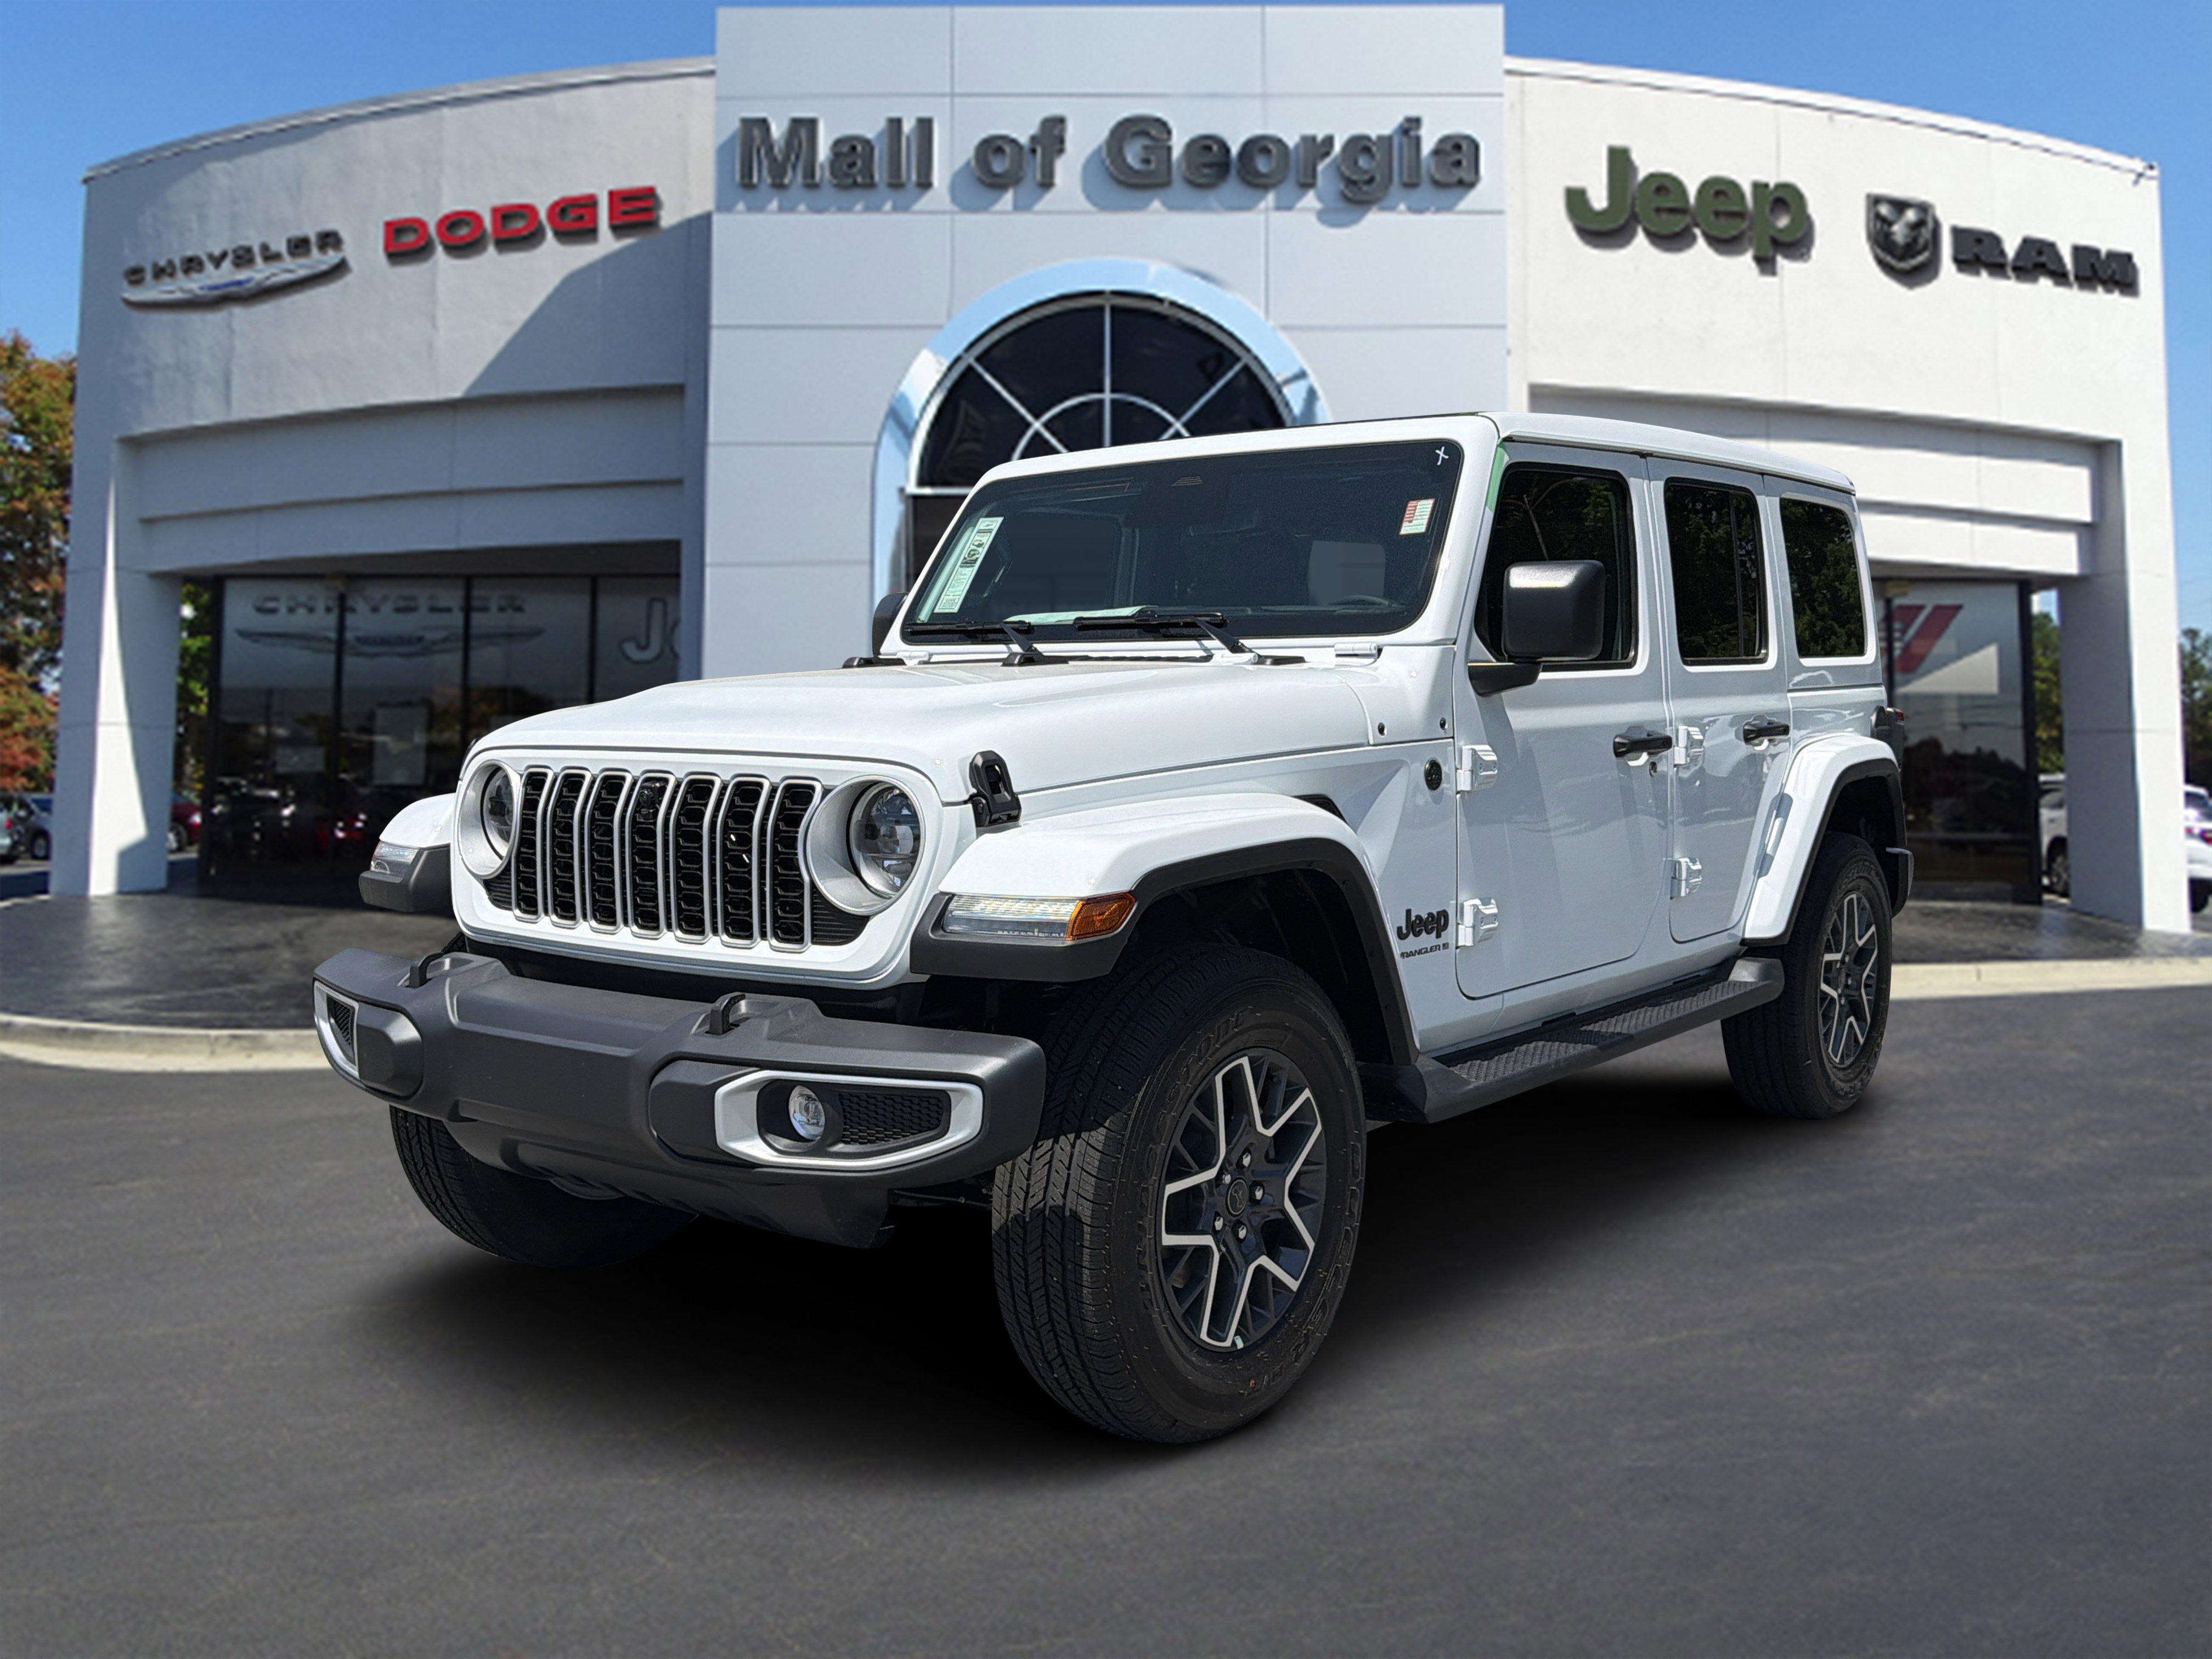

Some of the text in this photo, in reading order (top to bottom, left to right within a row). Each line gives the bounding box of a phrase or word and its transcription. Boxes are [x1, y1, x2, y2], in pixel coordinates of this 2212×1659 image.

[736, 114, 1482, 205] Mall of Georgia
[382, 185, 659, 259] DODGE
[1564, 144, 1810, 263] Jeep
[123, 229, 345, 286] CHRYSLER
[1949, 224, 2137, 294] RAM
[1396, 908, 1449, 940] Jeep
